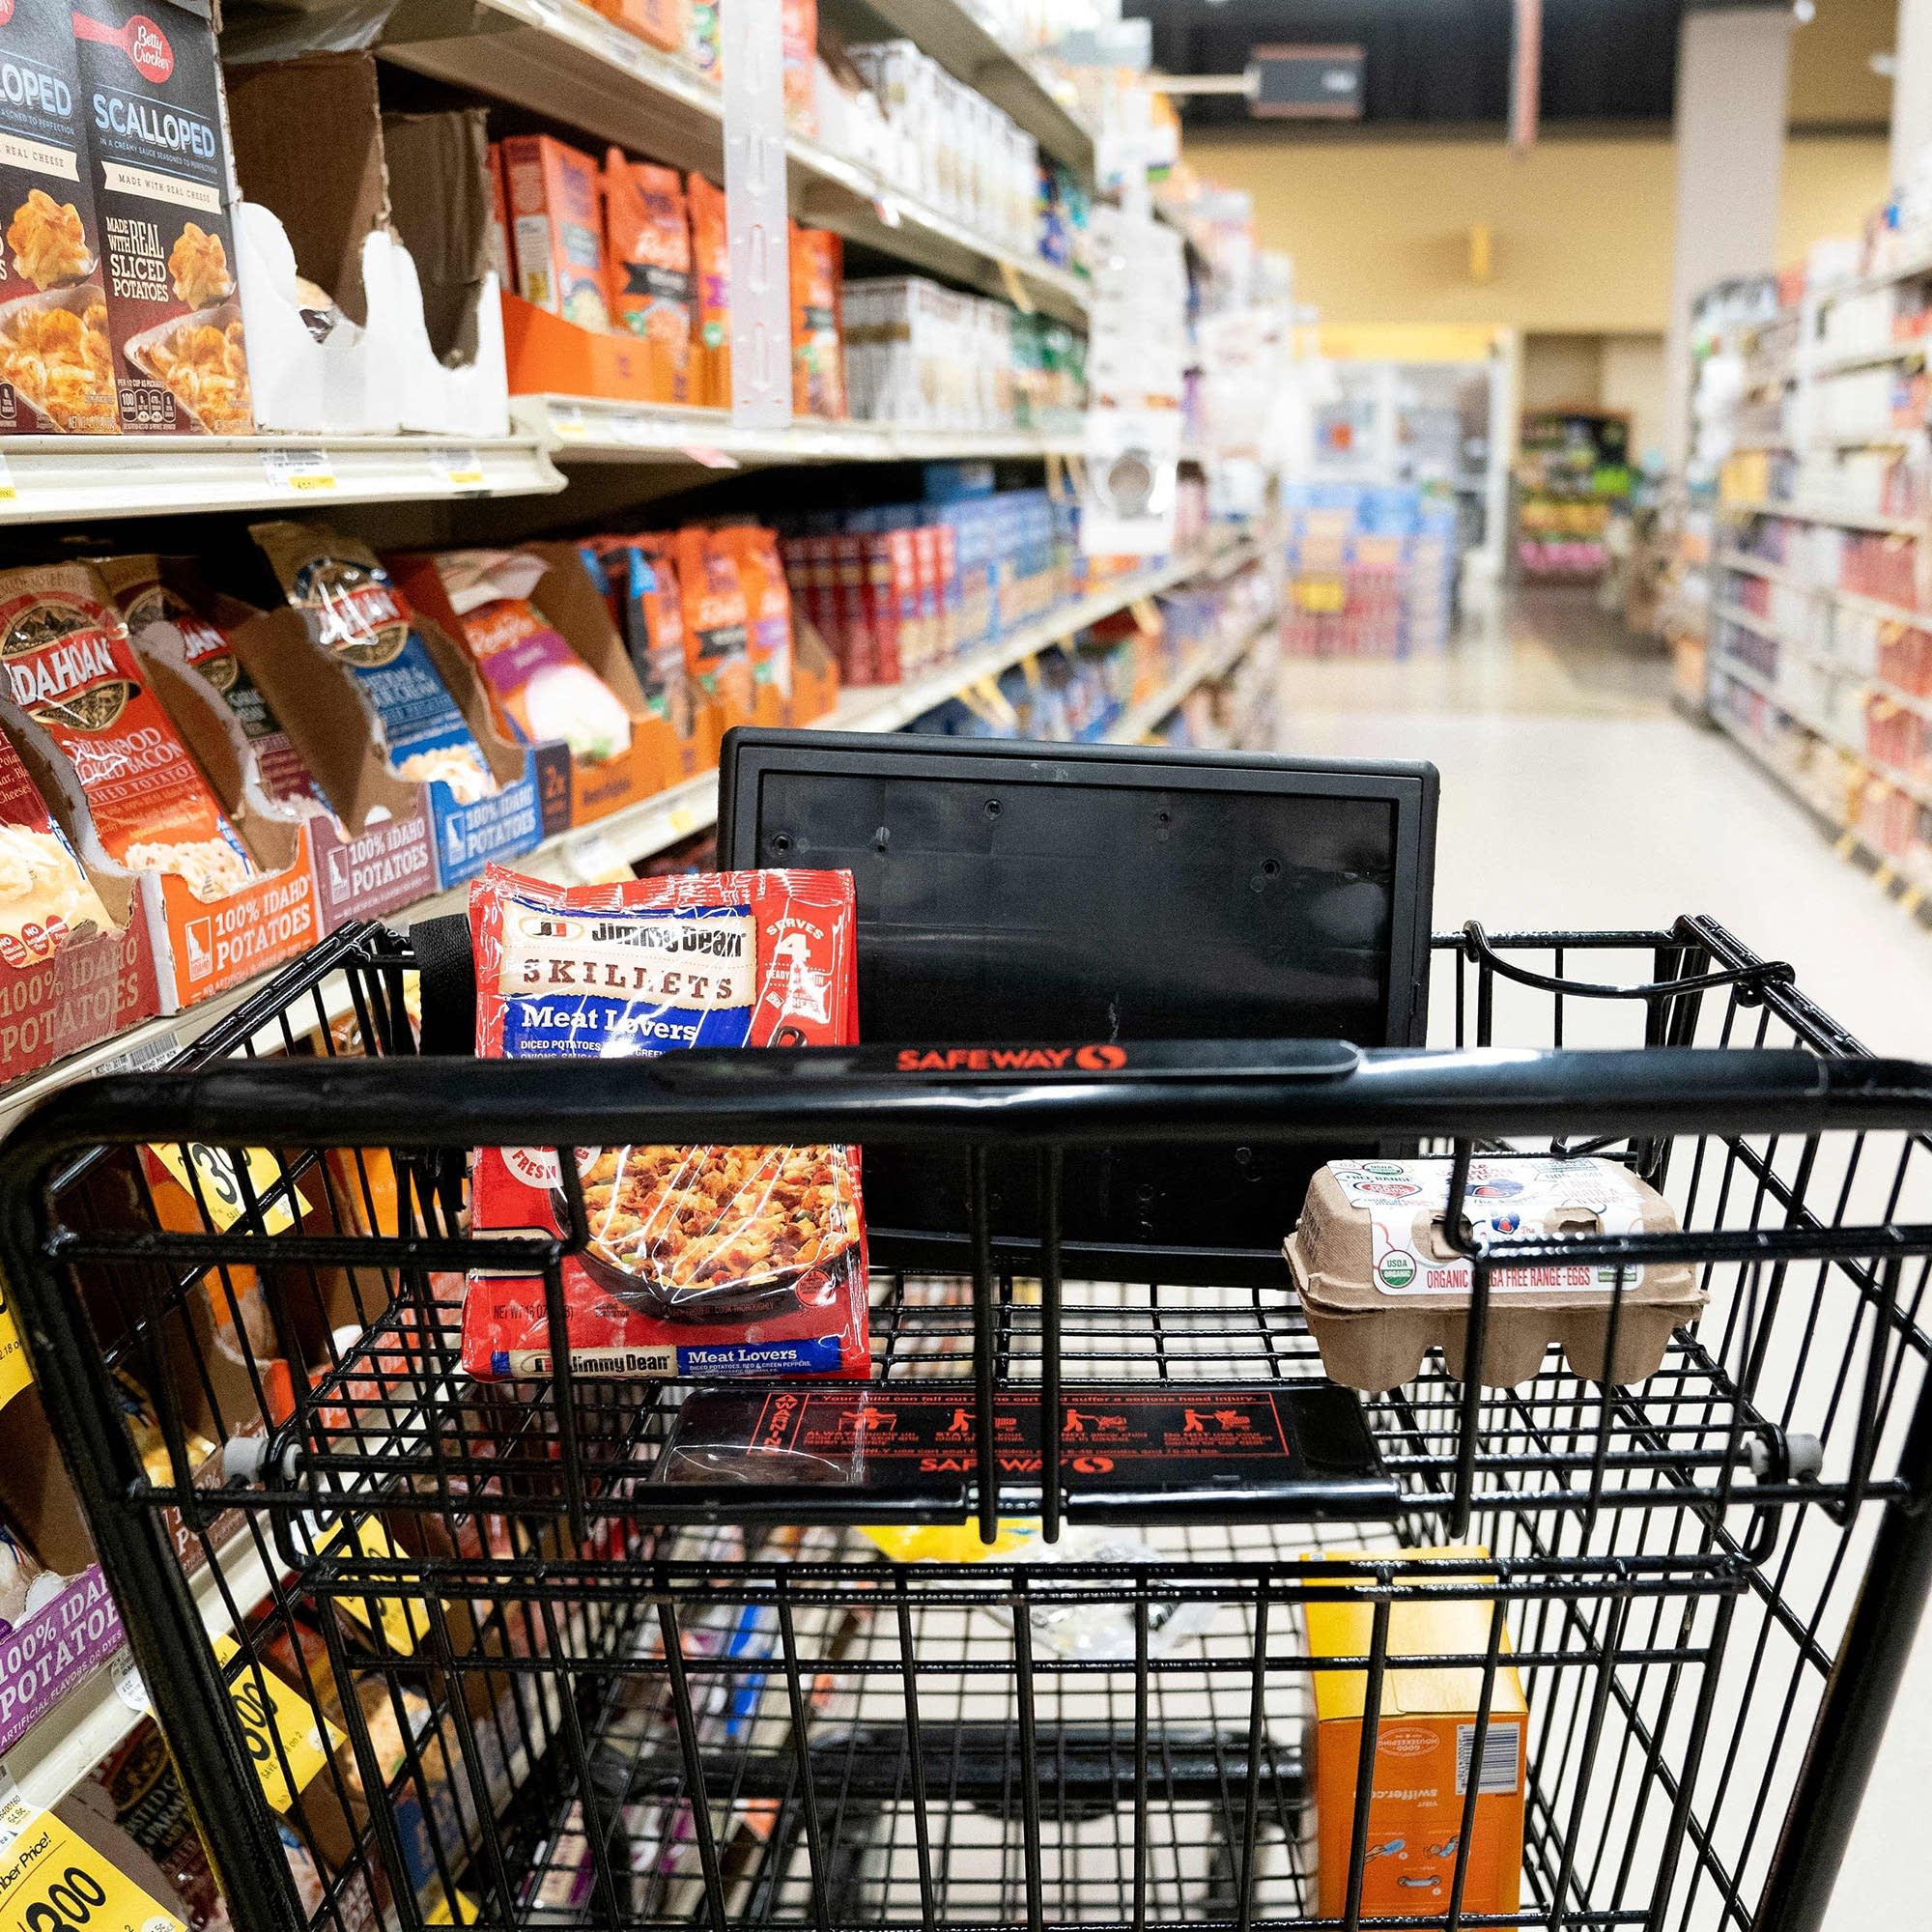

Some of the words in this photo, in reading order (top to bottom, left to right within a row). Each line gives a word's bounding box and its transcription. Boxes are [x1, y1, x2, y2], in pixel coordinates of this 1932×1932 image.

[138, 26, 162, 56] Betty
[133, 42, 170, 71] Crocker
[38, 119, 75, 136] PERFECTION
[93, 94, 217, 160] SCALLOPED
[6, 145, 28, 159] REAL
[32, 152, 66, 169] CHEESE
[114, 141, 138, 153] CREAMY
[118, 173, 143, 187] MADE
[145, 179, 164, 192] WITH
[166, 185, 185, 196] REAL
[186, 189, 212, 204] CHEESE
[106, 216, 129, 235] MADE
[128, 219, 165, 260] REAL
[107, 234, 131, 253] WITH
[110, 253, 167, 283] SLICED
[112, 277, 170, 302] POTATOES
[122, 392, 134, 406] 100
[3, 636, 119, 707] IDAHOAN
[127, 743, 186, 774] BACON
[89, 786, 128, 805] SHED
[349, 834, 386, 866] 100%
[386, 817, 426, 852] IDAHO
[468, 808, 537, 858] POTATOES
[352, 841, 430, 897] POTATOES
[215, 897, 261, 937] 100%
[263, 875, 309, 917] IDAHO
[24, 925, 40, 937] NO
[216, 902, 311, 972] POTATOES
[591, 922, 681, 953] Jimmy
[681, 924, 743, 958] Dean
[765, 918, 825, 941] SERVES
[775, 932, 811, 962] 4
[0, 969, 65, 1018] 100%
[71, 936, 139, 990] IDAHO
[523, 957, 732, 1000] SKILLETS
[0, 972, 140, 1064] POTATOES
[520, 1004, 600, 1031] Meat
[604, 1009, 699, 1041] Lovers
[520, 1039, 551, 1050] DICED
[896, 1047, 1074, 1072] SAFEWAY
[512, 1149, 557, 1179] FRESH
[1520, 1225, 1536, 1236] The
[1382, 1269, 1413, 1279] ORGANIC
[1386, 1258, 1408, 1268] USDA
[1426, 1269, 1469, 1289] ORGANIC
[1505, 1267, 1529, 1287] FREE
[570, 1354, 626, 1374] Jimmy
[625, 1352, 668, 1371] Dean
[688, 1350, 735, 1364] Meat
[737, 1349, 798, 1362] Lovers
[921, 1395, 942, 1405] fall
[919, 1457, 1068, 1473] SAFWA
[0, 1616, 57, 1686] 100%
[60, 1572, 109, 1631] IDA
[0, 1597, 120, 1724] POTATOE
[0, 1699, 49, 1747] ARTIFICIAL
[49, 1660, 88, 1700] FLAVORS
[89, 1649, 102, 1664] OR
[102, 1629, 124, 1654] DYES
[260, 1760, 278, 1780] SAVE
[289, 1738, 300, 1749] on
[1353, 1788, 1438, 1802] swiffer.c
[18, 1831, 53, 1869] Price!
